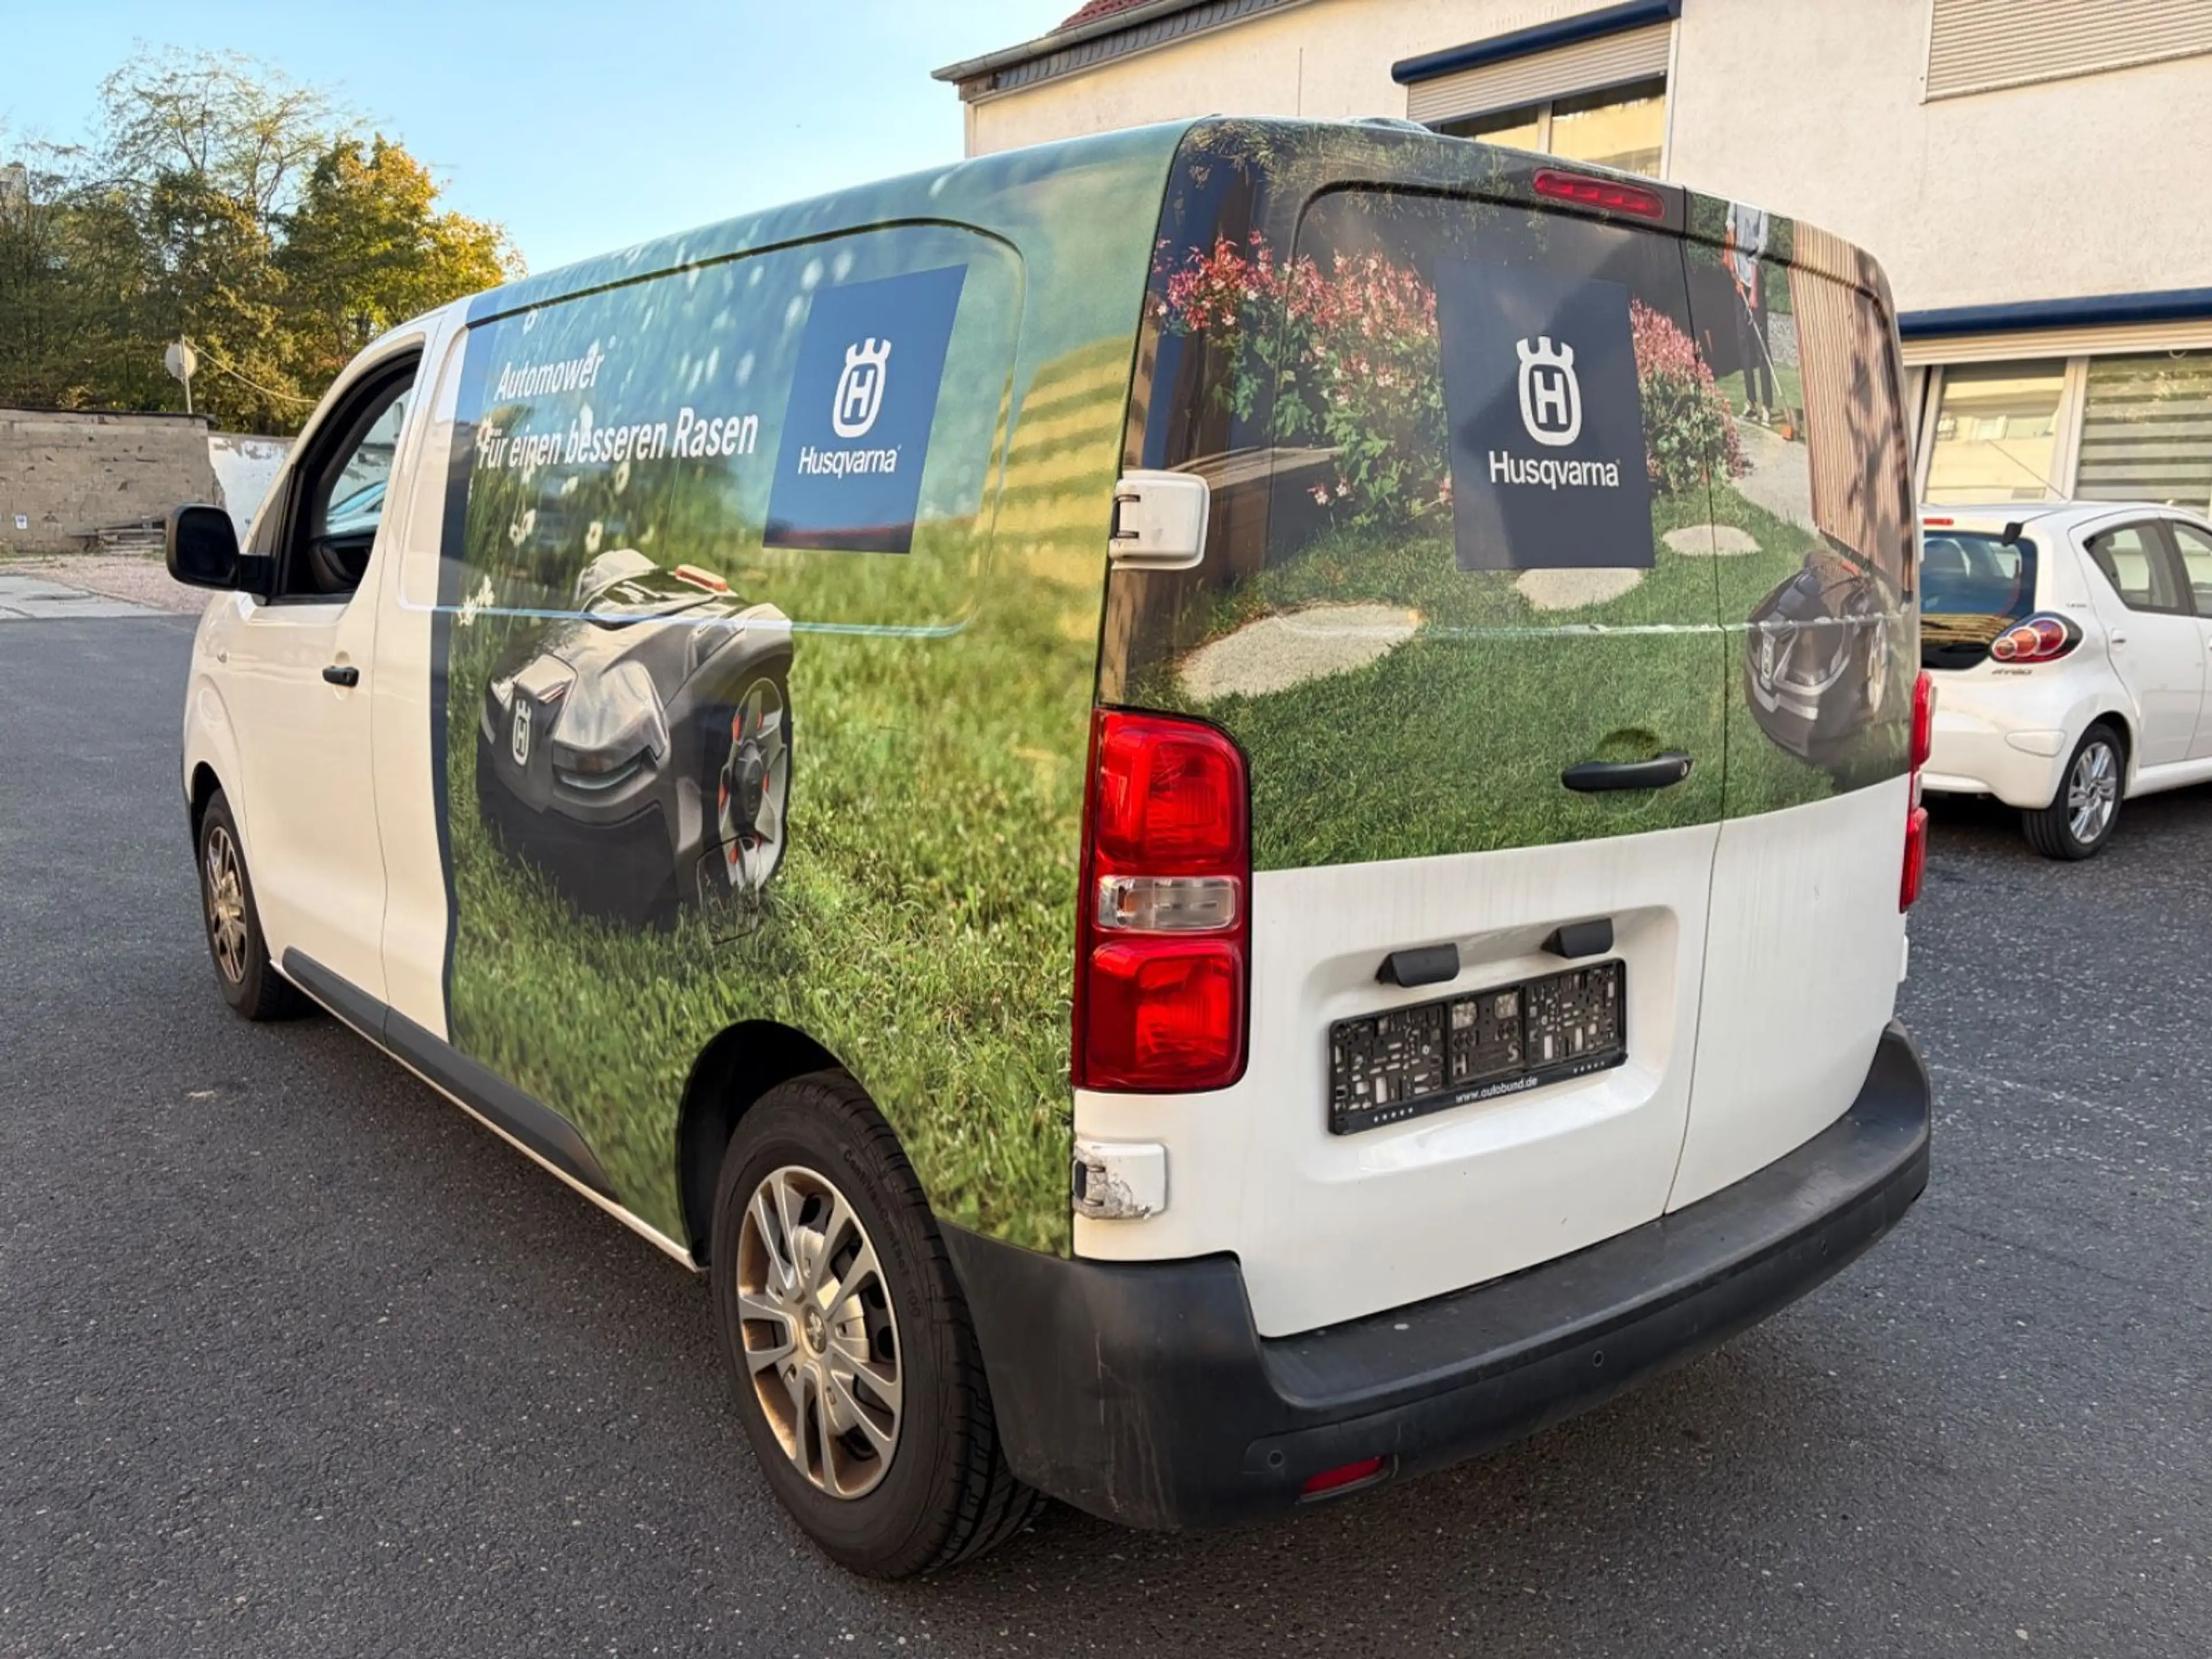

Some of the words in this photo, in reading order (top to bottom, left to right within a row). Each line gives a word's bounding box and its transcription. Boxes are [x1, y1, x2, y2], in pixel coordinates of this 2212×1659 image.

[493, 353, 605, 402] Automower
[509, 424, 563, 468] einen
[564, 418, 668, 465] besseren
[672, 407, 759, 459] Rasen
[797, 445, 899, 479] Husqvarna
[1488, 450, 1620, 490] Husqvarna
[1455, 1075, 1539, 1104] www.autobund.de
